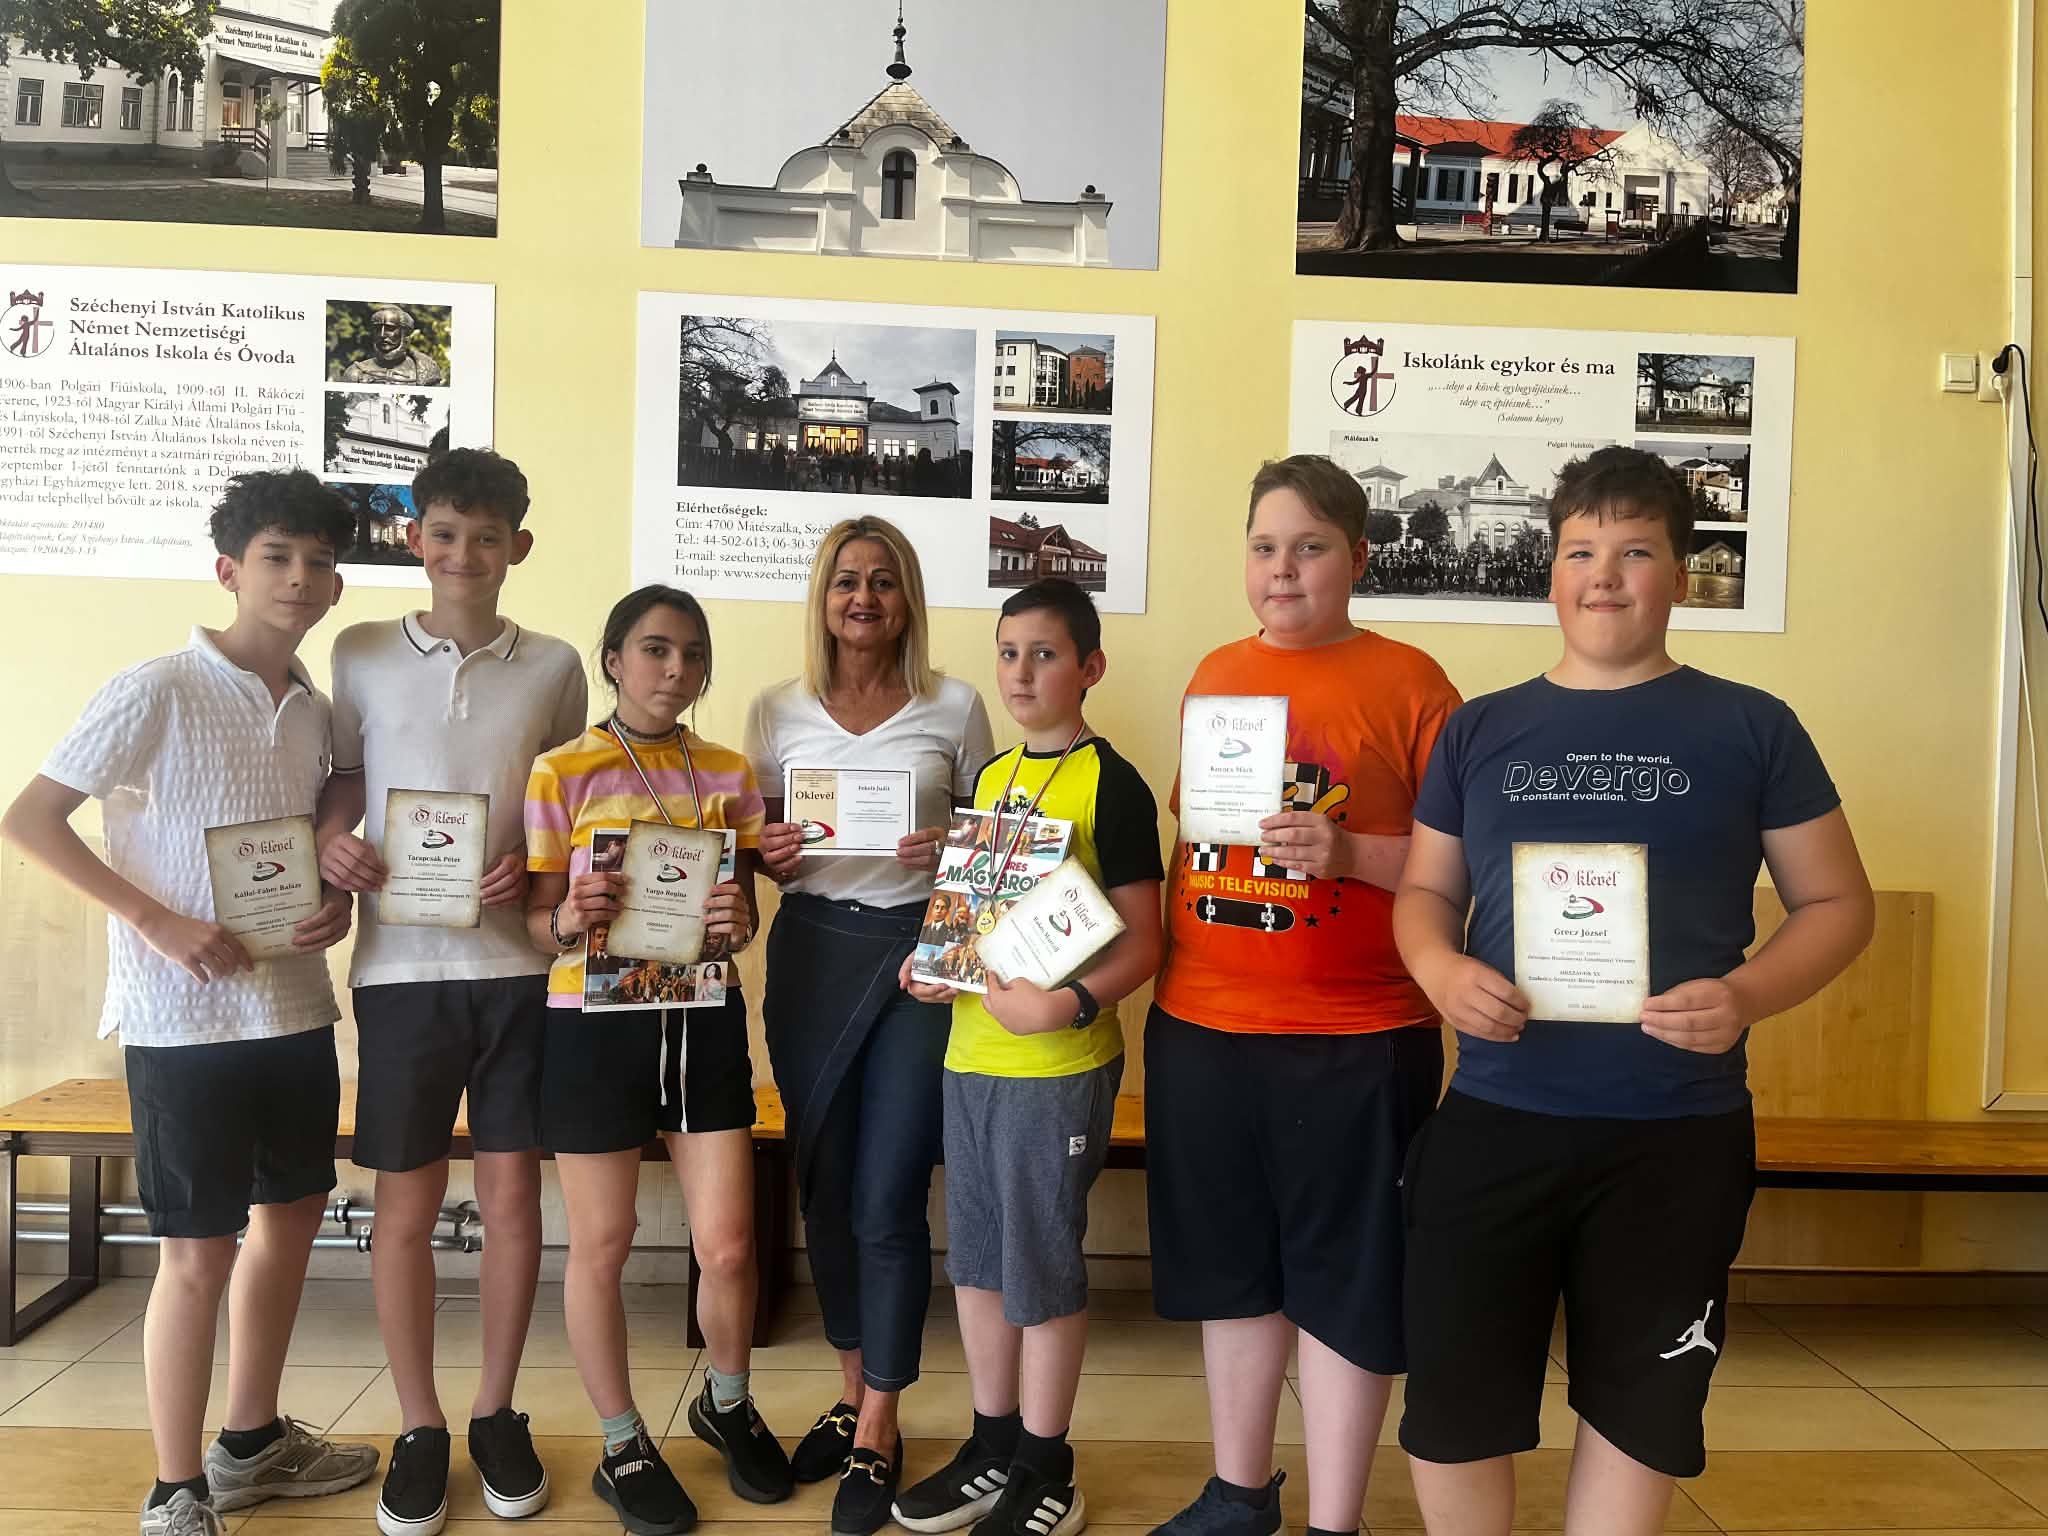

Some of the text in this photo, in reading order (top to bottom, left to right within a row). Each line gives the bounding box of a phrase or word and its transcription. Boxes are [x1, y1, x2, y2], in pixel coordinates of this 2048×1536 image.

[70, 297, 305, 321] Széchenyi István Katolikus
[69, 319, 246, 344] Német Nemzetiségi
[69, 337, 296, 364] Általános Iskola és Óvoda
[1403, 350, 1616, 377] Iskolánk egykor és ma
[61, 379, 101, 395] Polgári
[111, 381, 167, 396] Fiúiskola,
[235, 385, 249, 398] II.
[258, 387, 305, 401] Rákóczi
[97, 397, 140, 412] Magyar
[144, 398, 183, 414] Királyi
[190, 399, 227, 413] Állami
[231, 402, 272, 417] Polgári
[1459, 398, 1479, 409] ideje
[1480, 400, 1491, 410] az
[13, 410, 78, 425] Lányiskola,
[135, 414, 168, 427] Zalka
[172, 415, 202, 429] Máté
[207, 414, 261, 430] Általános
[266, 419, 305, 434] Iskola,
[1497, 412, 1564, 425] (Salamon könyve)
[49, 427, 106, 443] Széchenyi
[111, 430, 147, 443] István
[152, 429, 207, 444] Általános
[212, 433, 247, 446] Iskola
[251, 435, 287, 448] néven
[40, 445, 65, 459] meg
[67, 446, 80, 456] az
[83, 446, 148, 462] intézményt
[151, 449, 158, 458] a
[160, 449, 211, 461] szatmári
[0, 458, 64, 473] zeptember
[116, 460, 187, 476] fenntartónk
[194, 467, 202, 477] a
[0, 475, 39, 490] gyházi
[43, 475, 126, 491] Egyházmegye
[155, 479, 189, 491] 2018.
[191, 482, 228, 497] szept
[38, 491, 104, 508] telephellyel
[107, 494, 146, 507] bővült
[149, 498, 163, 507] az
[675, 502, 768, 519] Elérhetőségek:
[675, 517, 704, 530] Cím:
[705, 520, 734, 530] 4700
[737, 520, 802, 535] Mátészalka,
[675, 549, 717, 561] E-mail:
[675, 564, 721, 581] Honlap:
[1566, 752, 1673, 764] Open to the world.
[1502, 761, 1691, 802] Devergo
[795, 790, 835, 801] Oklevél
[1522, 792, 1570, 802] constant
[1573, 791, 1628, 802] evolution.
[1189, 873, 1310, 899] MUSIC TELEVISION
[614, 1460, 643, 1480] PUMA
